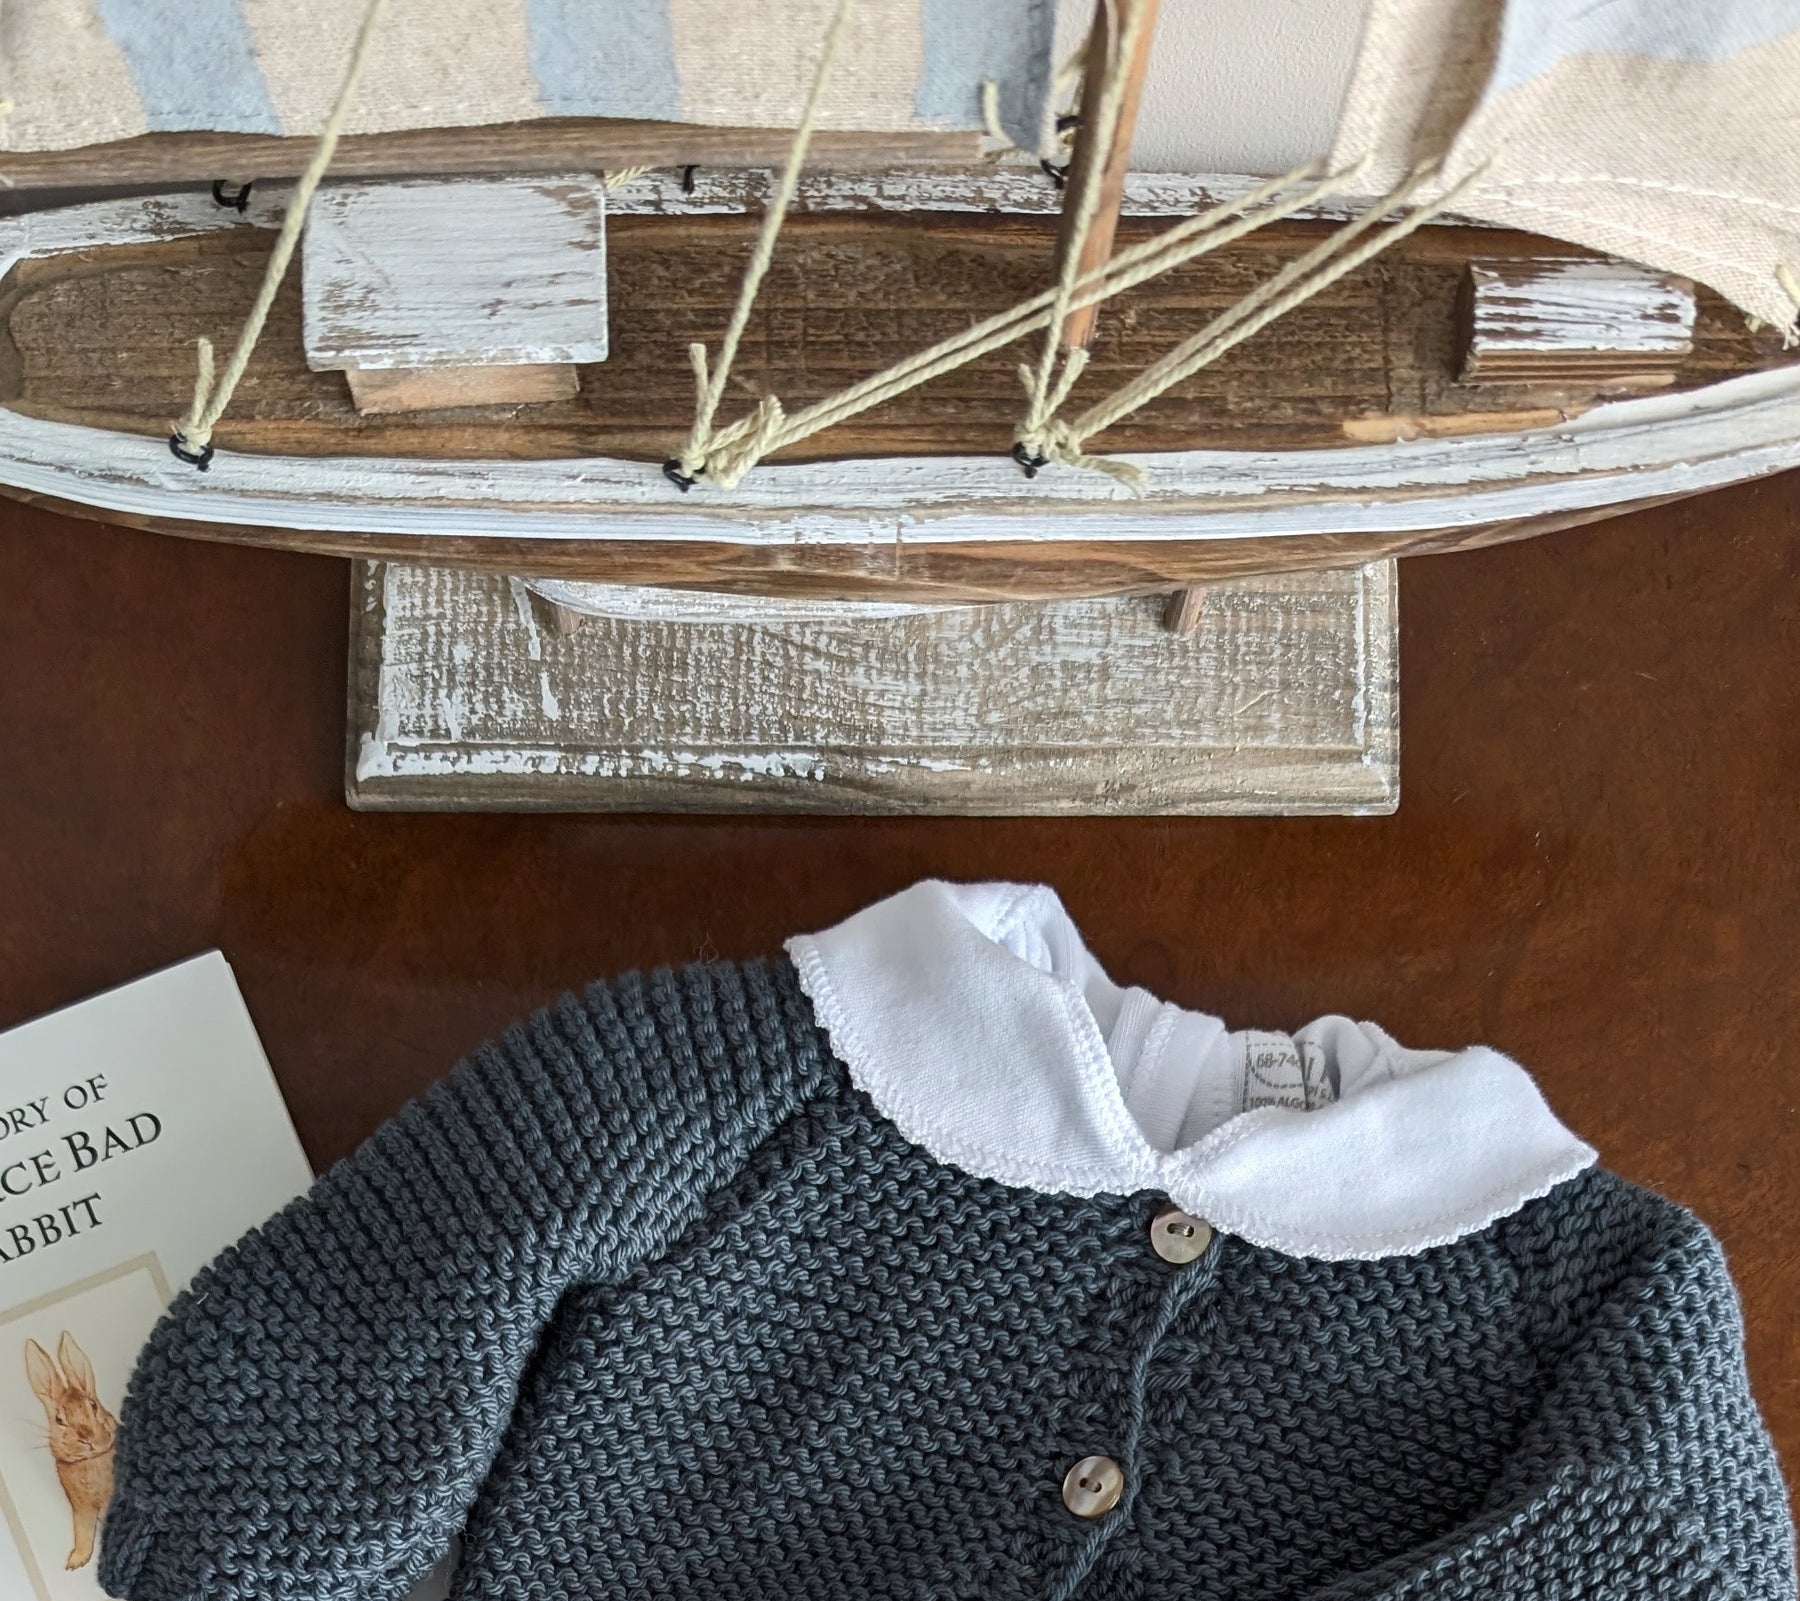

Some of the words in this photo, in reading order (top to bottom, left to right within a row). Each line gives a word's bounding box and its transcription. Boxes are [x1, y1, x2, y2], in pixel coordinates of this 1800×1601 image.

[63, 1073, 109, 1110] OF
[0, 1149, 62, 1200] CE
[61, 1112, 162, 1173] BAD
